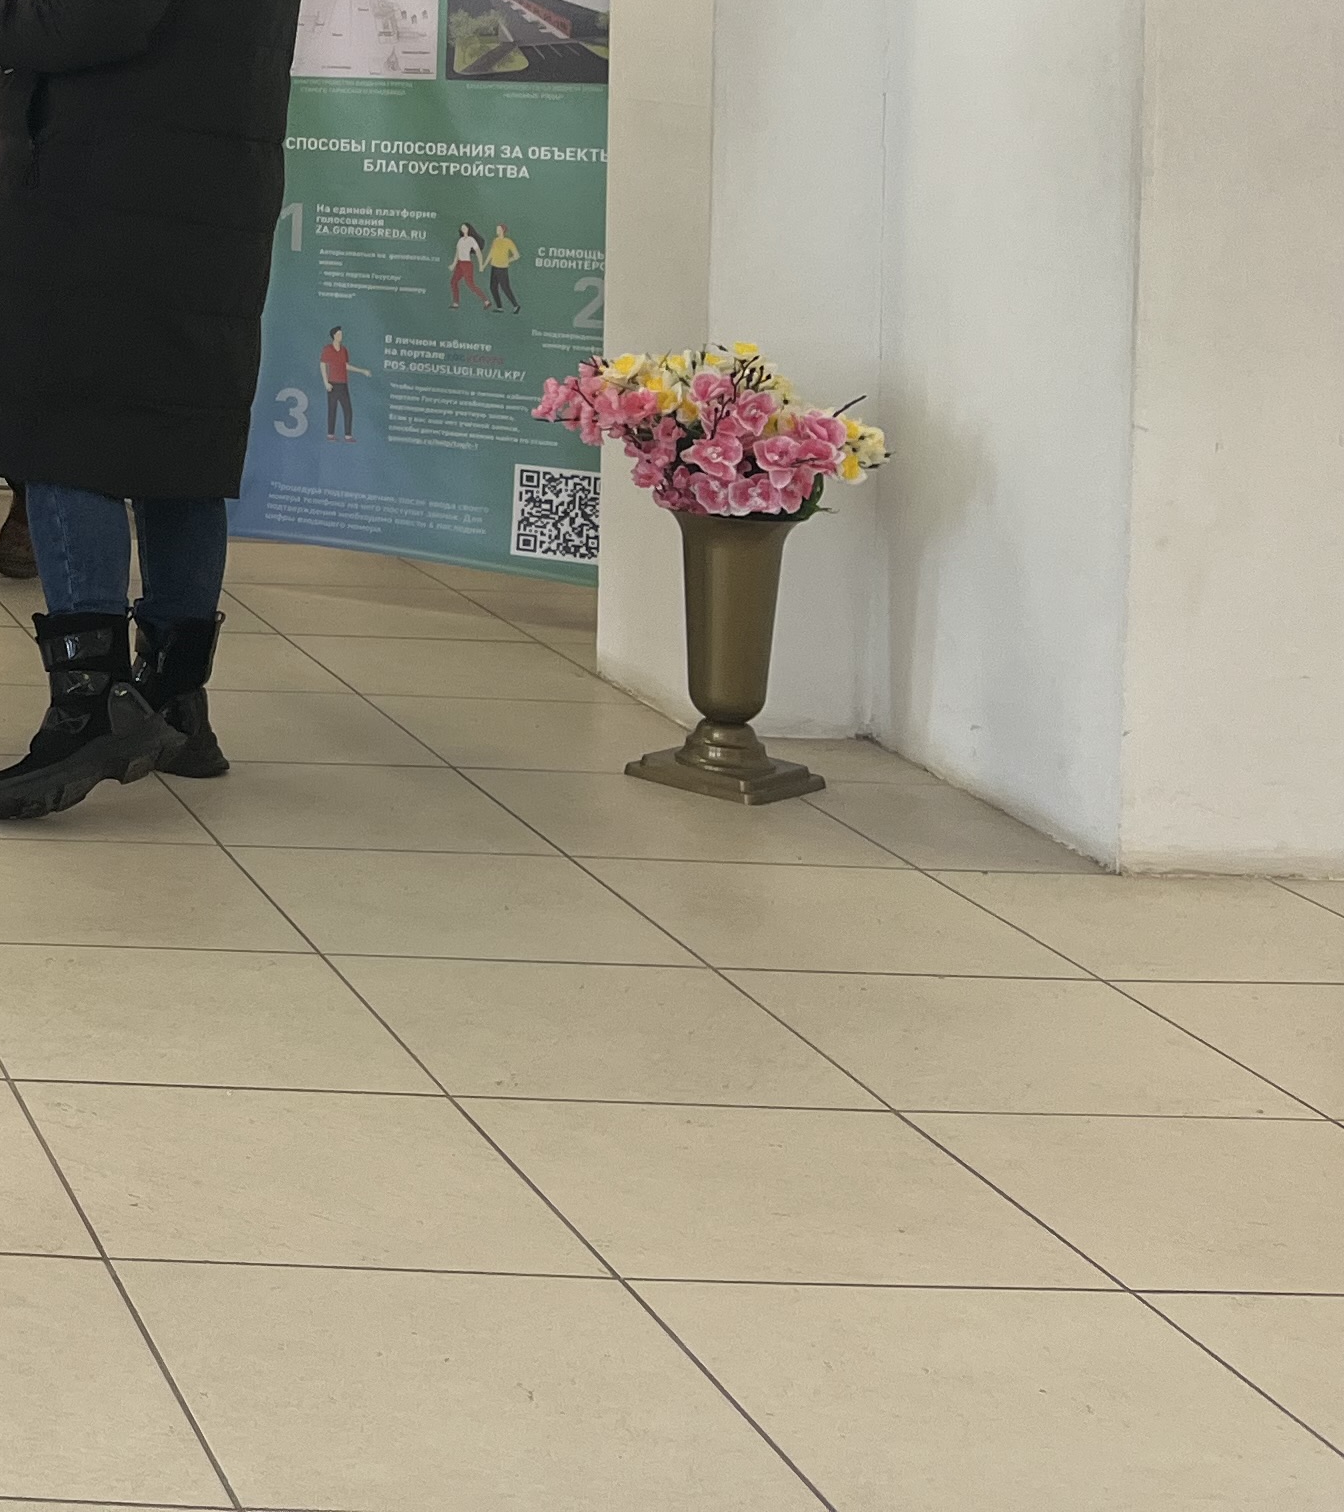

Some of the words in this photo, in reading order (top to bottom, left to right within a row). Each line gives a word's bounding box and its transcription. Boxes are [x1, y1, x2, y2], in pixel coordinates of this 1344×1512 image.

[285, 136, 366, 153] СПОСОБЫ
[371, 140, 496, 159] ГОЛОСОВАНИЯ
[500, 145, 524, 160] ЗА
[363, 158, 530, 180] БЛАГОУСТРОЙСТВА
[316, 203, 330, 213] На
[280, 202, 303, 252] 1
[315, 225, 427, 241] ZA.GORODSREDA.RU
[538, 247, 546, 257] С
[548, 247, 605, 260] ПОМОЩЬ
[400, 349, 445, 360] портале
[273, 388, 309, 438] 3
